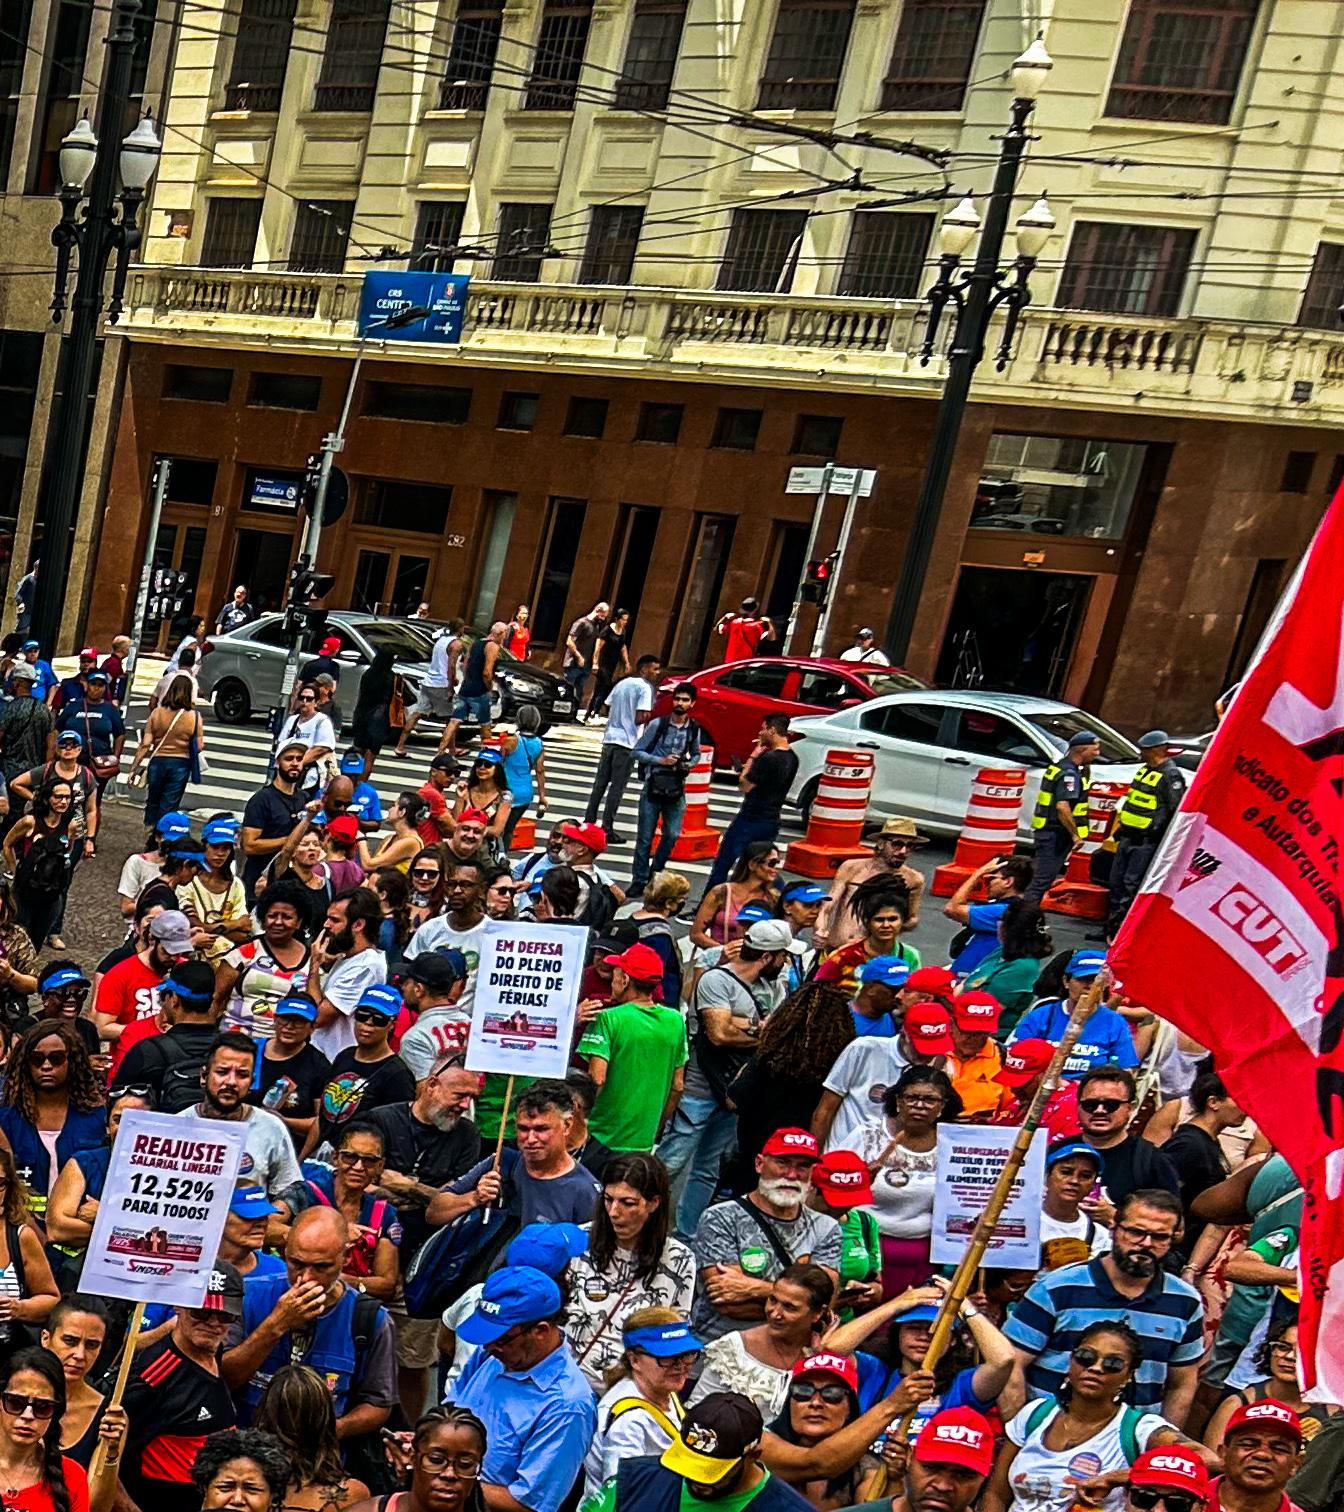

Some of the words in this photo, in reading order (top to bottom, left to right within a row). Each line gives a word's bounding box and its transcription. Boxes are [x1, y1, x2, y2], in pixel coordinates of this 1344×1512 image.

[1287, 799, 1323, 836] dos
[495, 939, 515, 952] EM
[517, 941, 563, 956] DEFESA
[498, 989, 548, 1007] FÉRIAS!
[133, 1134, 227, 1164] REAJUSTE
[130, 1172, 215, 1203] 12,52%
[121, 1197, 159, 1216] PARA
[162, 1203, 210, 1221] TODOS!
